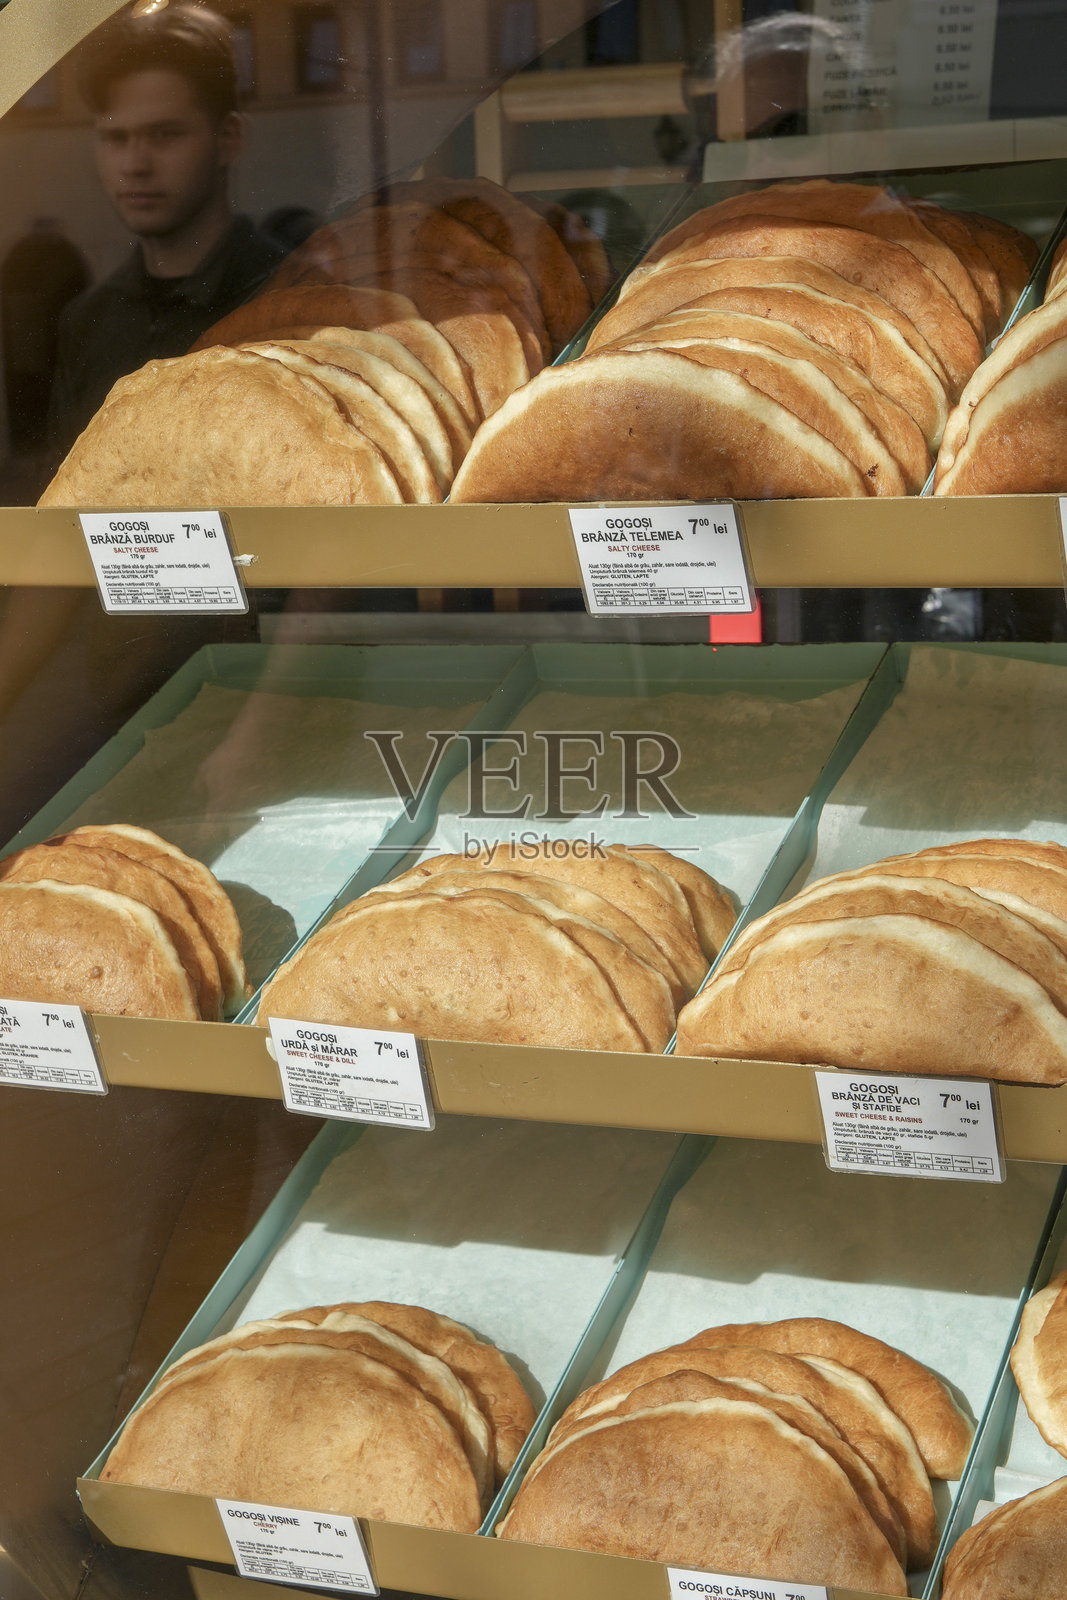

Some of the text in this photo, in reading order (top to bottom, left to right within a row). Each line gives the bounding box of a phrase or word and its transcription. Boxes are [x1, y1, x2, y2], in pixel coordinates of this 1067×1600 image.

[109, 522, 149, 532] GOGOȘI
[606, 518, 652, 530] GOGOȘI
[714, 523, 728, 534] lei
[90, 533, 175, 545] BRÂNZĂ BURDUF
[204, 529, 216, 538] lei
[582, 530, 683, 542] BRÂNZĂ TELEMEA
[63, 1020, 75, 1028] lei
[296, 1029, 337, 1043] GOGOȘI
[281, 1039, 309, 1051] URDĂ
[322, 1044, 358, 1057] MĂRAR
[397, 1048, 409, 1058] lei
[287, 1050, 308, 1059] SWEET
[309, 1053, 334, 1062] CHEESE
[849, 1083, 899, 1096] GOGOȘI
[832, 1092, 920, 1105] BRÂNZĂ DE VACI
[966, 1099, 980, 1110] lei
[852, 1102, 902, 1113] ȘI STAFIDE
[896, 1116, 923, 1124] RAISINS
[227, 1510, 300, 1526] GOGOȘI VIȘINE
[335, 1529, 347, 1537] lei
[679, 1581, 776, 1600] GOGOȘI CĂPȘUNI
